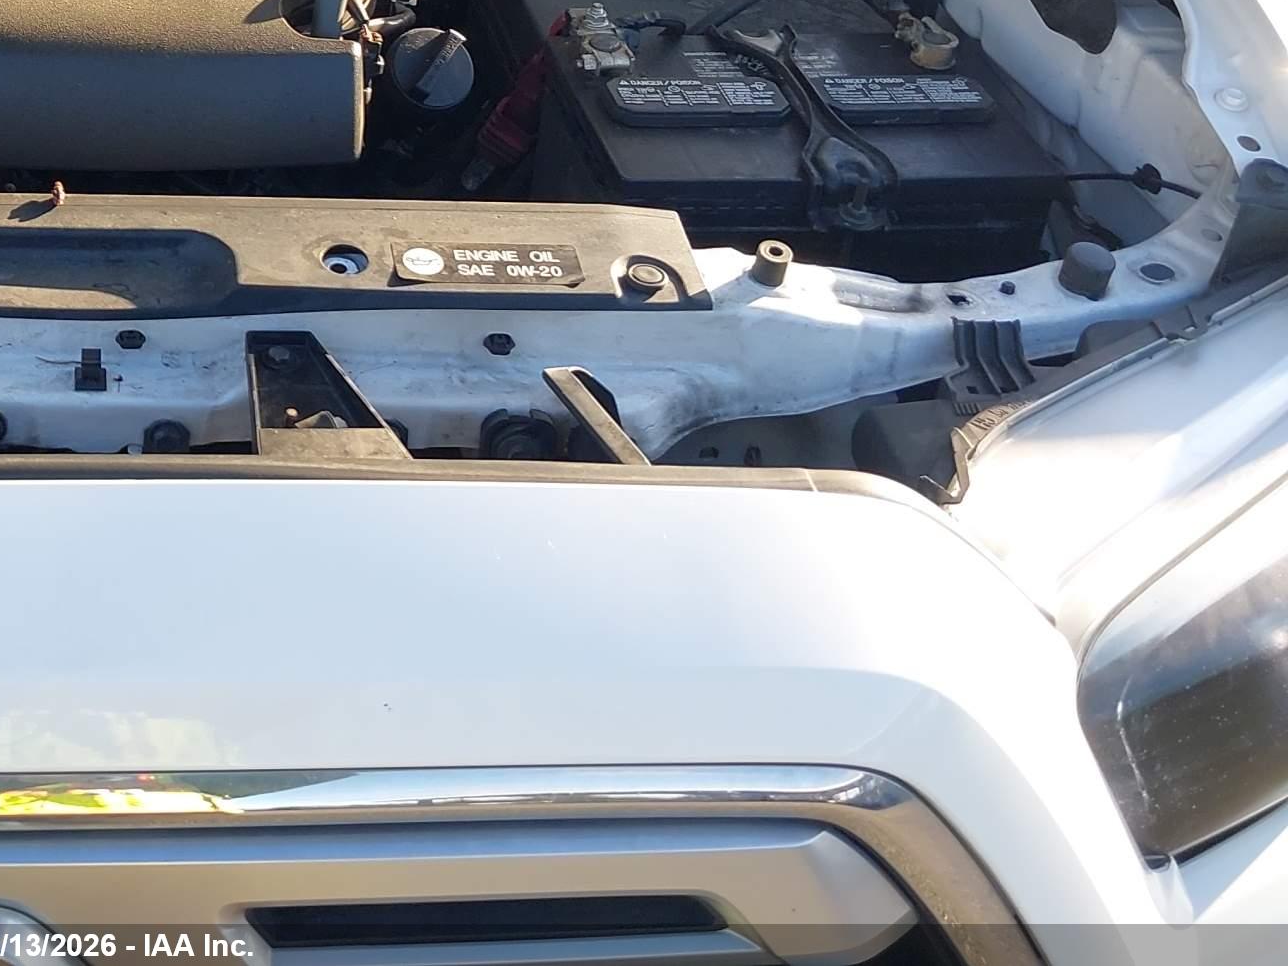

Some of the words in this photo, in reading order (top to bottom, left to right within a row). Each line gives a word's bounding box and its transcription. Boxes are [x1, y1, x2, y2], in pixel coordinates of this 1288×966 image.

[452, 249, 521, 263] ENGINE
[528, 250, 561, 263] OIL
[457, 263, 496, 276] SAE
[506, 265, 563, 277] 0W-20
